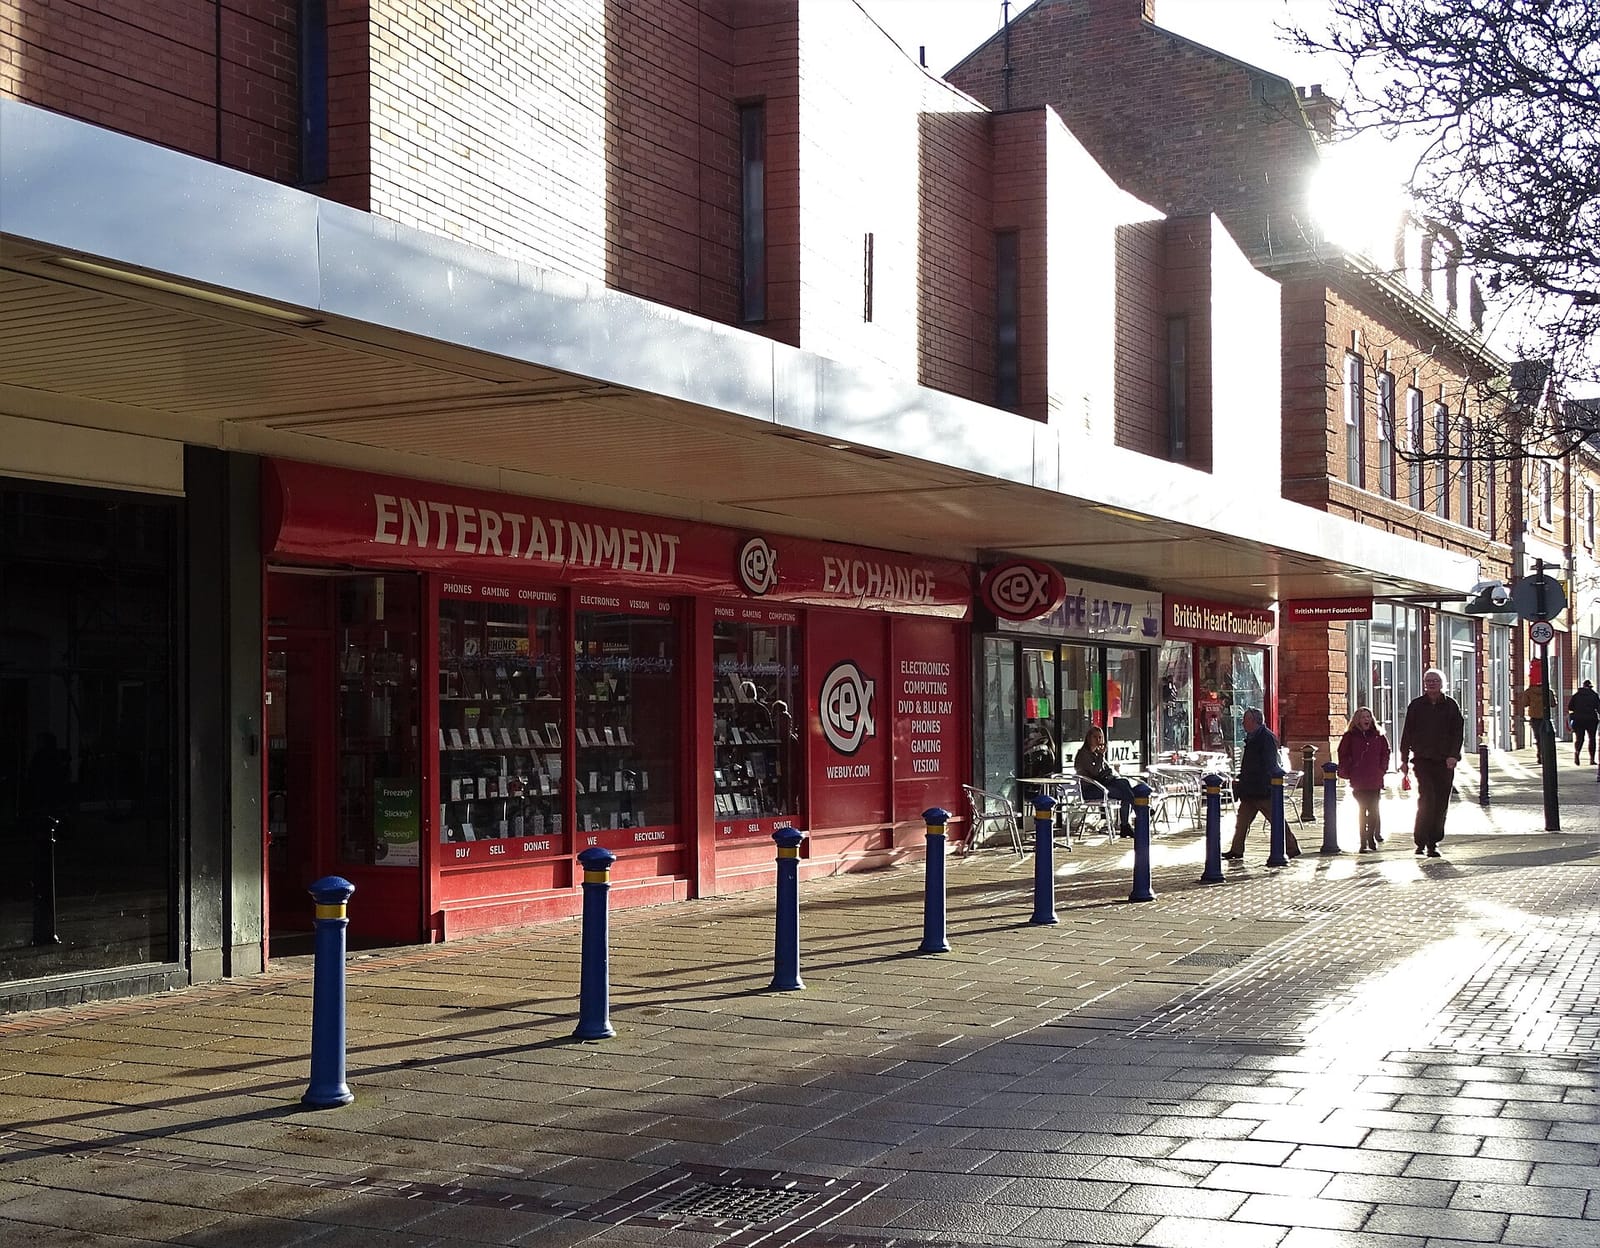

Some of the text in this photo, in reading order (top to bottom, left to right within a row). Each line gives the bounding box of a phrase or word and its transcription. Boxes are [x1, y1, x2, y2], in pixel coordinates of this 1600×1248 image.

[374, 493, 681, 576] ENTERTAINMENT
[822, 556, 936, 603] EXCHANGE
[443, 583, 557, 602] PHONES GAMING COMPUTING
[580, 595, 671, 612] ELECTRONICS VISION DVD
[1040, 587, 1133, 635] AFÉ JAZZ
[1294, 606, 1368, 615] British Heart Foundation
[714, 607, 796, 622] PHONES GAMING COMPUTING
[1173, 603, 1272, 637] British Heart Foundation
[900, 660, 950, 676] ELECTRONICS
[903, 680, 948, 696] COMPUTING
[898, 700, 953, 716] DVD & BLU RAY
[911, 720, 941, 734] PHONES
[911, 739, 941, 753] GAMING
[1111, 747, 1130, 761] JAZZ
[826, 765, 870, 779] WEBUY.COM
[912, 759, 940, 773] VISION
[383, 789, 413, 798] Freezing?
[384, 809, 412, 819] Sticking?
[723, 820, 792, 835] BU SELL DONATE
[587, 831, 665, 845] WE RECYCLING
[489, 844, 506, 855] SELL
[523, 840, 550, 852] DONATE
